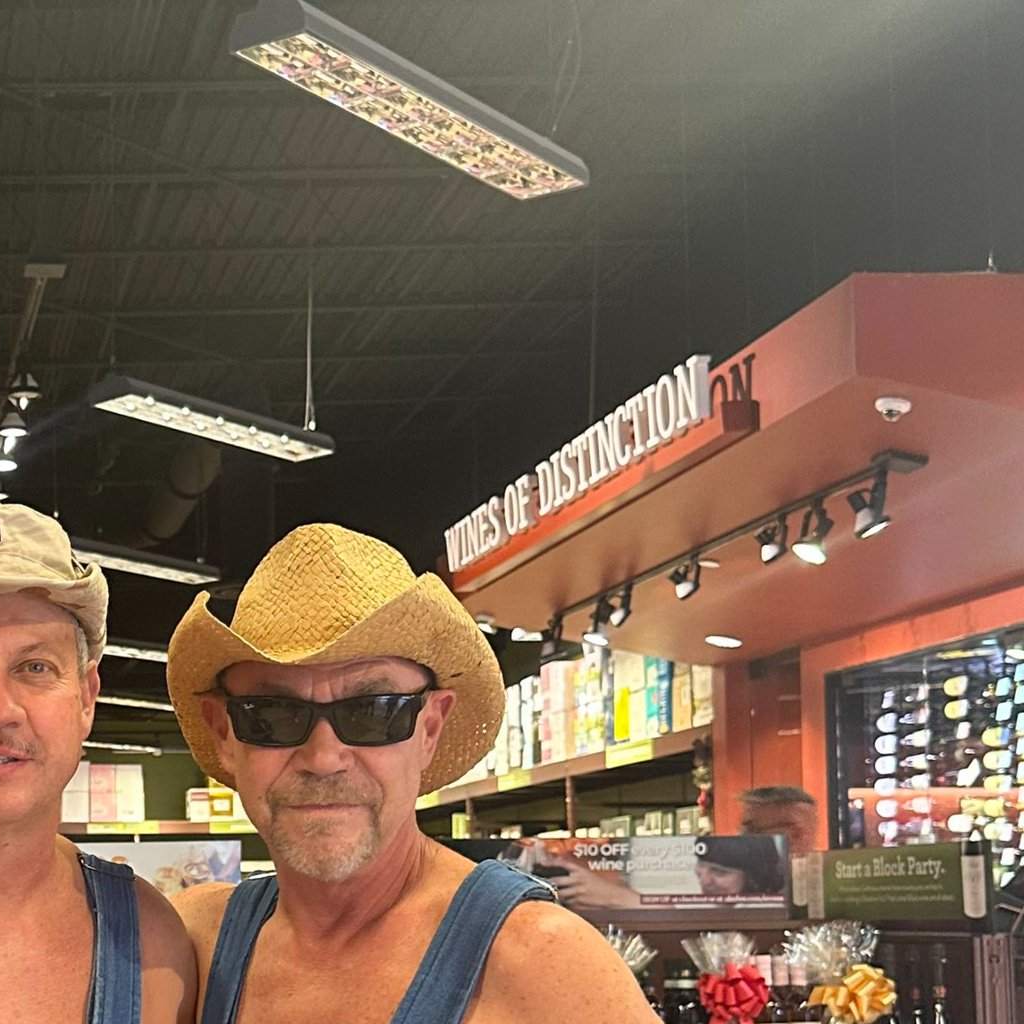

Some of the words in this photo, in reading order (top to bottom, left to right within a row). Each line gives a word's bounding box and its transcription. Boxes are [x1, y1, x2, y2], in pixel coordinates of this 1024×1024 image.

[444, 496, 502, 573] WINES
[503, 474, 536, 536] OF
[535, 355, 711, 517] DISTINCTION
[573, 842, 599, 858] $10
[600, 843, 629, 857] OFF
[588, 857, 624, 872] wine
[835, 860, 862, 879] Start
[864, 865, 871, 878] a
[873, 855, 906, 876] Block
[907, 856, 946, 879] Party.
